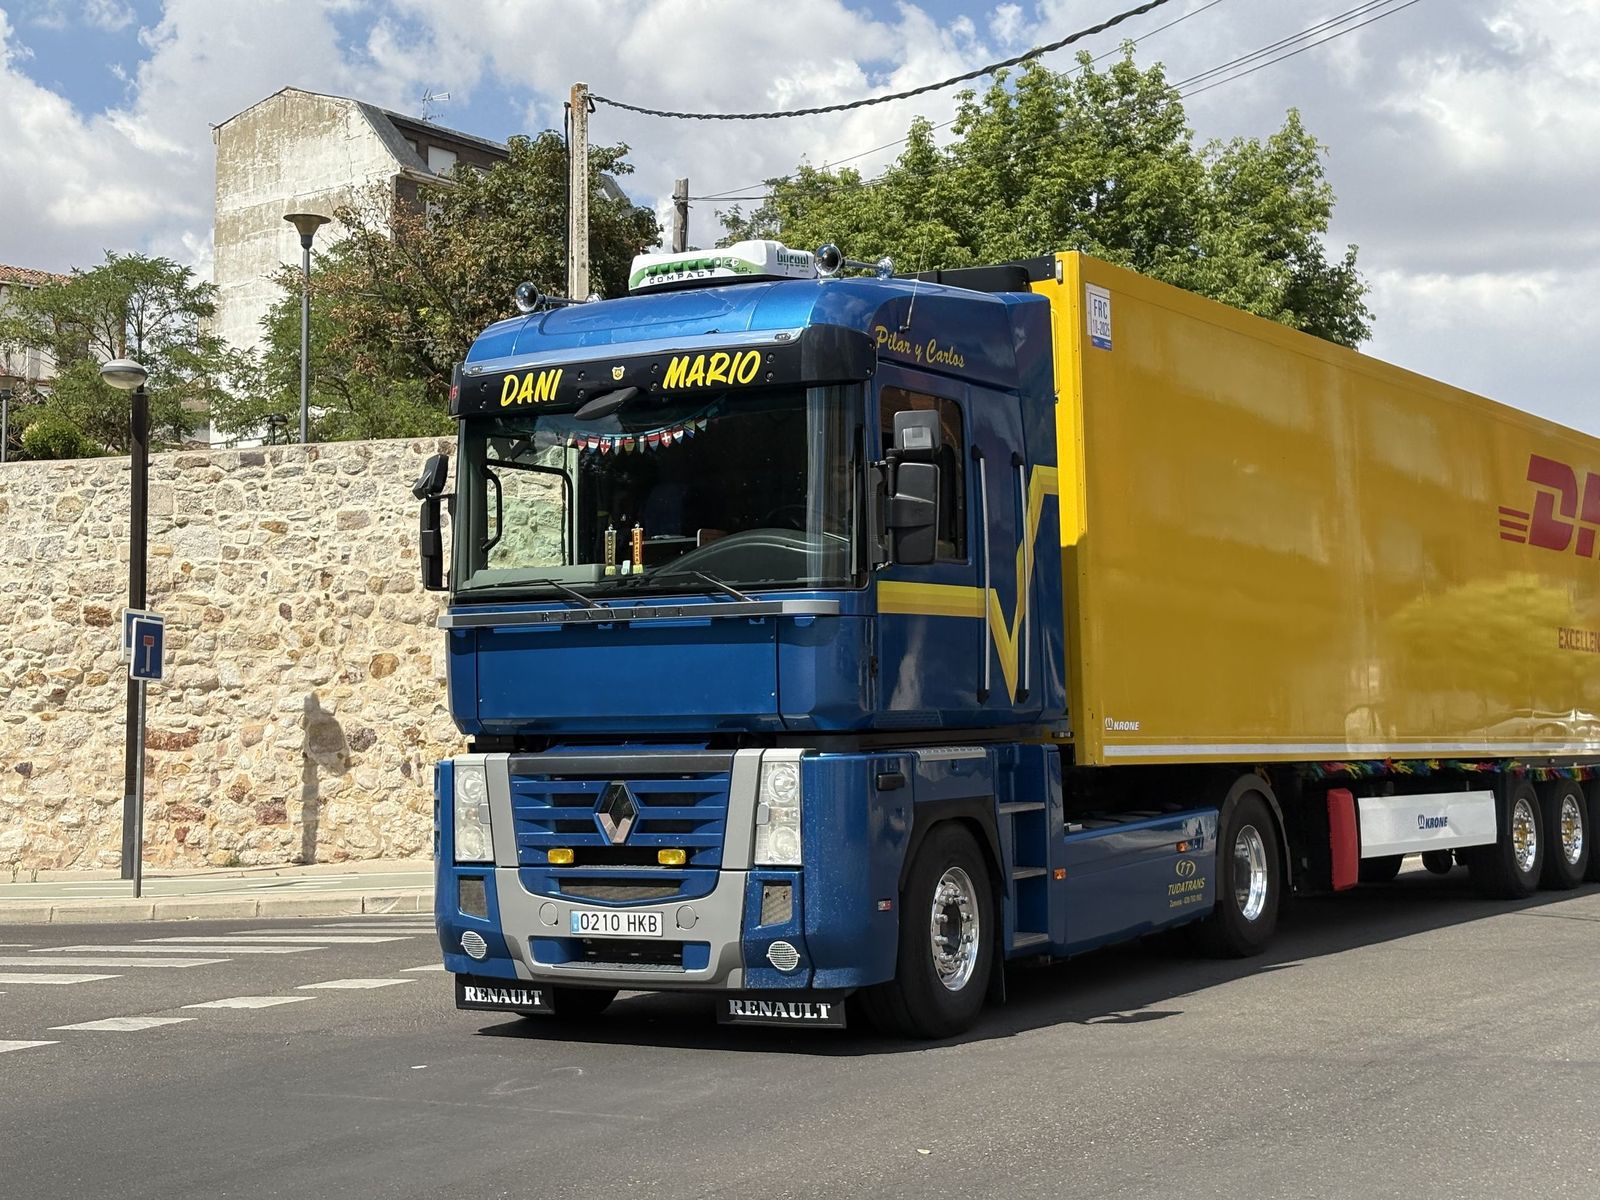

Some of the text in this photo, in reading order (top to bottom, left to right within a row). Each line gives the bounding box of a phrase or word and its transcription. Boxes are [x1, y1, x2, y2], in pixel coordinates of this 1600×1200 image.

[649, 270, 715, 284] COMPACT
[1093, 298, 1108, 320] FRC
[875, 325, 965, 368] Pilar y Carlos
[501, 350, 761, 407] DANI MARIO
[1114, 721, 1140, 731] KRONE
[1425, 816, 1448, 829] KRONE
[1168, 877, 1205, 896] TUDATRANS
[580, 913, 657, 932] 0210 HKB
[464, 986, 542, 1005] RENAULT
[729, 1000, 831, 1018] RENAULT
